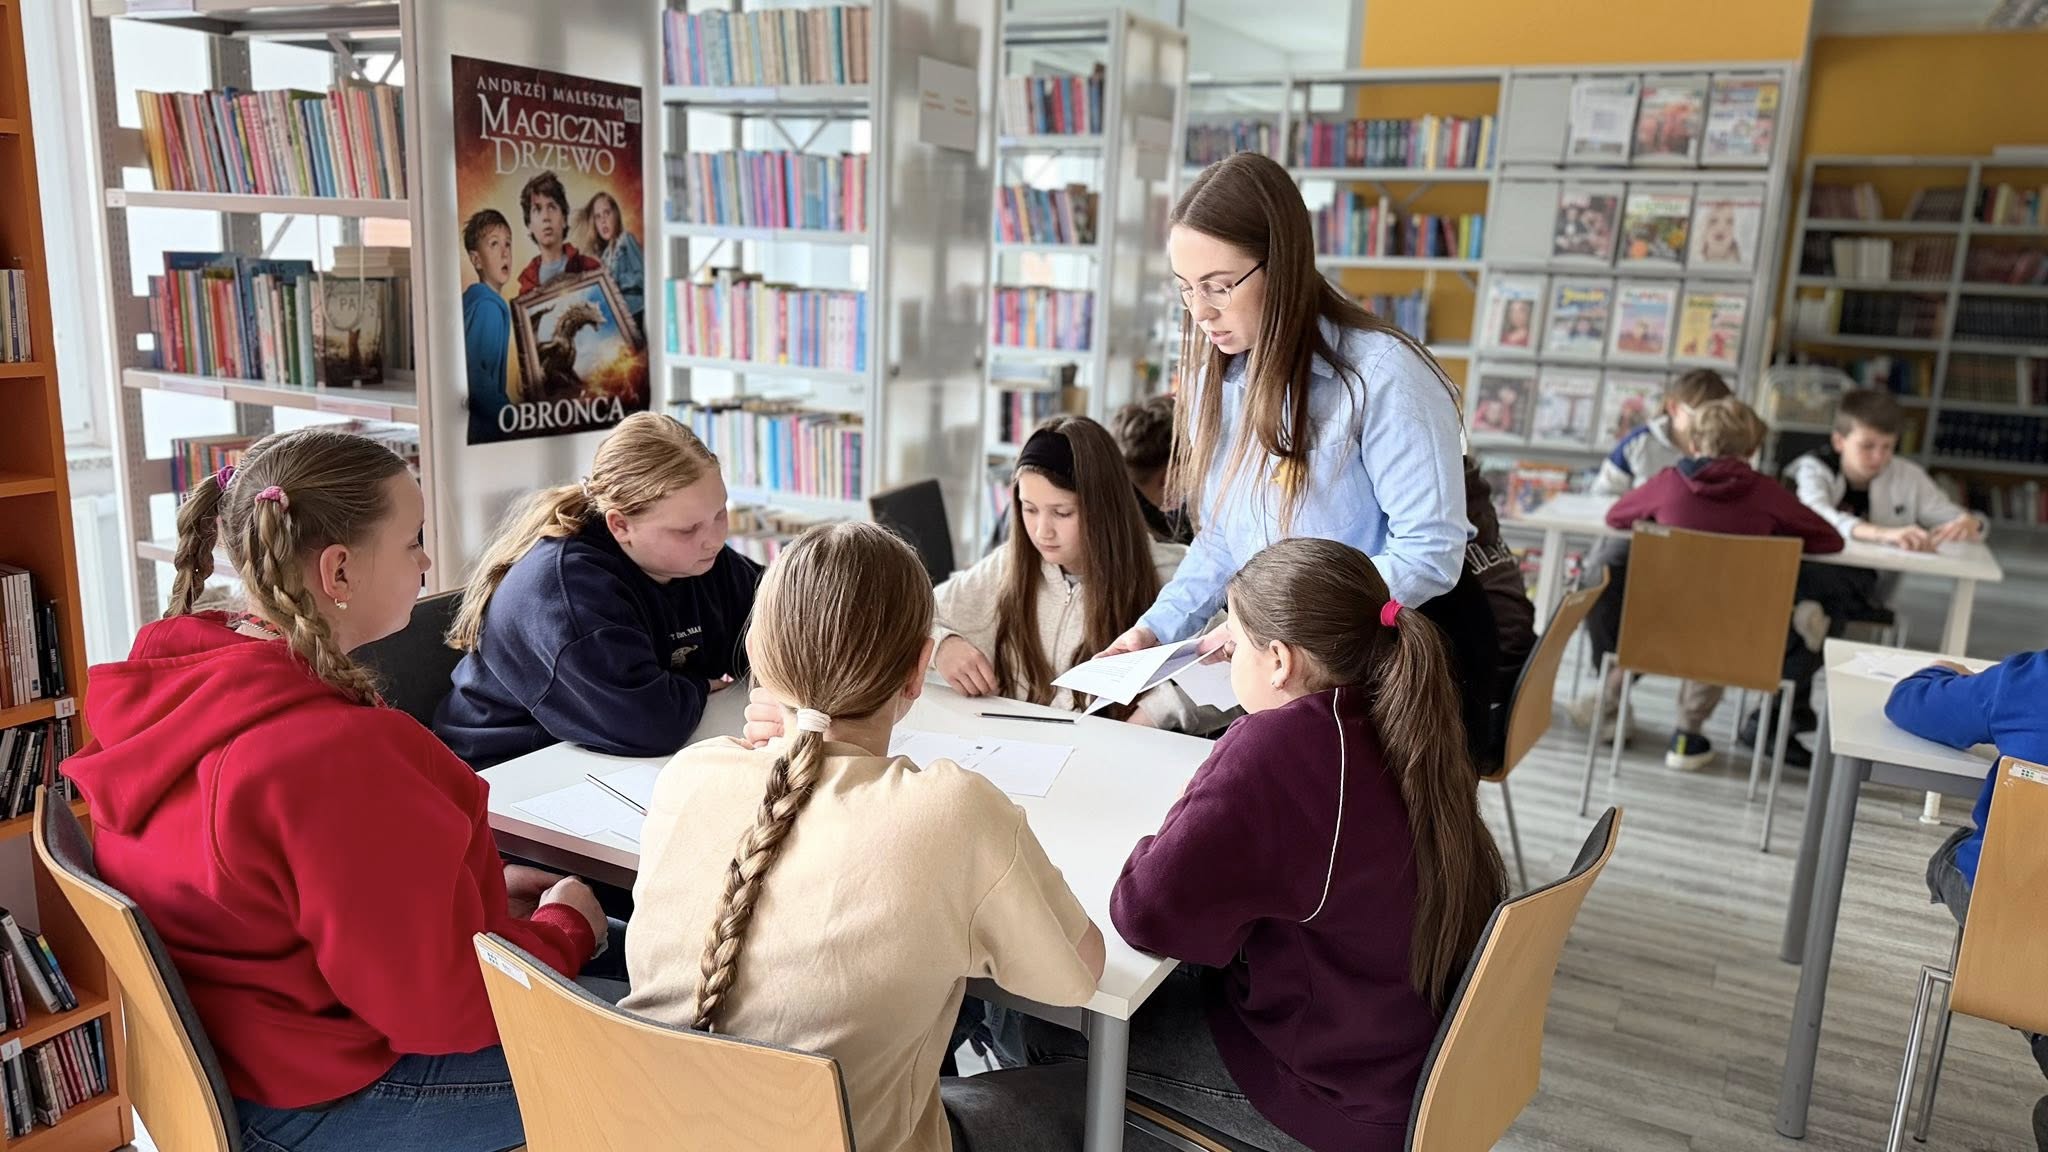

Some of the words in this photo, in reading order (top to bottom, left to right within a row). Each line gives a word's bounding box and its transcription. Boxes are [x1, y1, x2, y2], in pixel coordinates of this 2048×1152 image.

[477, 75, 546, 101] ANDRZEJ
[553, 87, 624, 111] MALESZKA
[477, 93, 627, 148] MAGICZNE
[489, 136, 616, 176] DRZEWO
[498, 389, 625, 433] OBROŃCA
[61, 700, 71, 715] H
